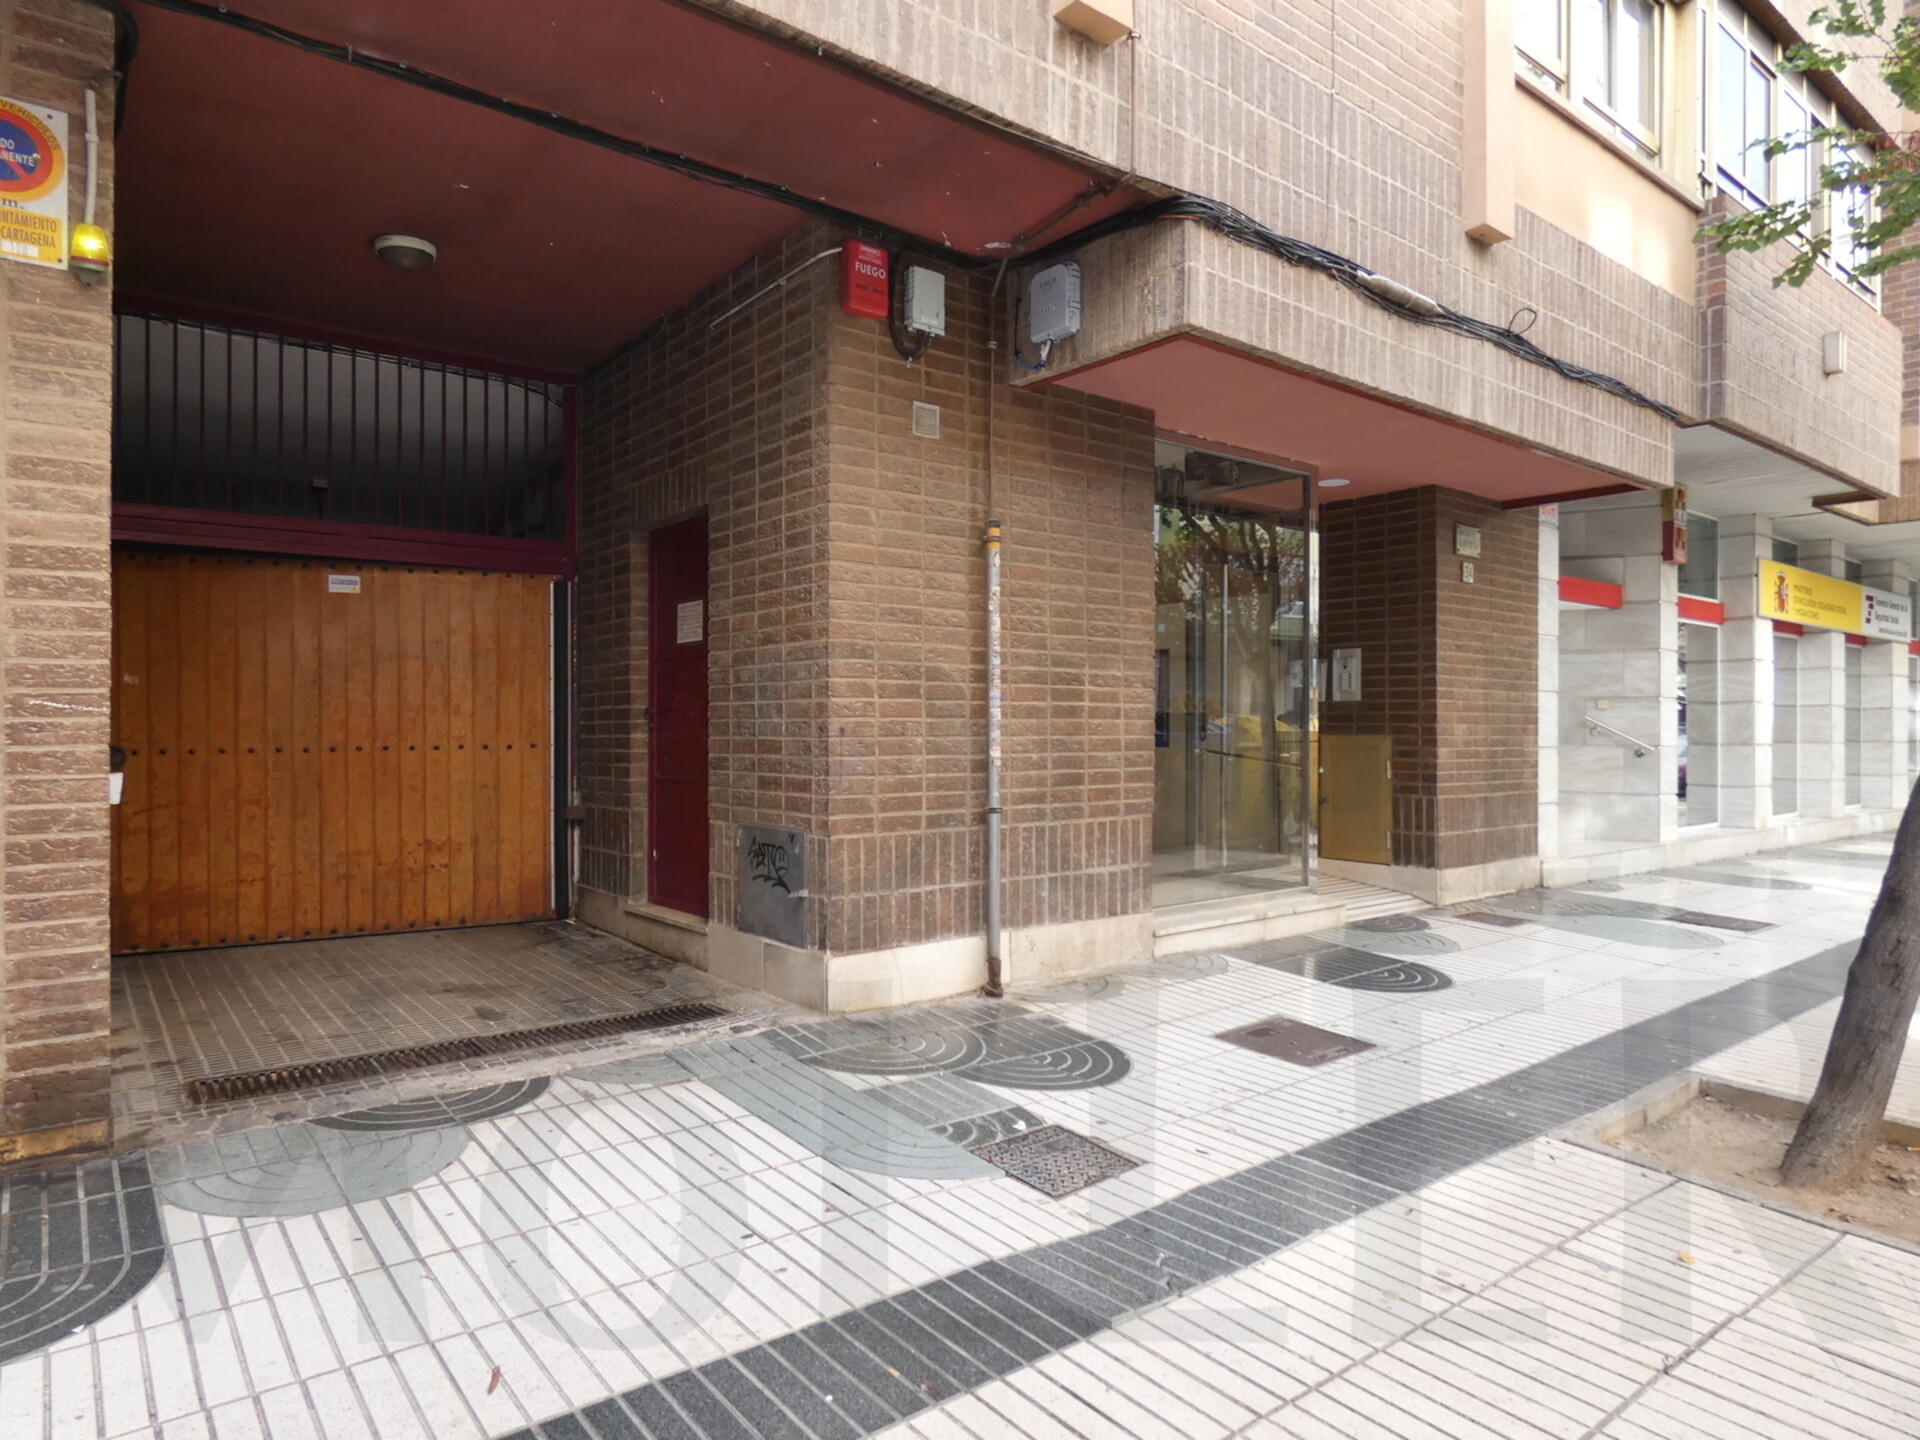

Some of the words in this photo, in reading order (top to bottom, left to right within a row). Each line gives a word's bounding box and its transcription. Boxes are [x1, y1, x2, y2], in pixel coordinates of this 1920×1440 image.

[0, 209, 57, 233] NTAMIENTO
[0, 226, 56, 248] CARTAGENA
[855, 261, 887, 279] FUEGO
